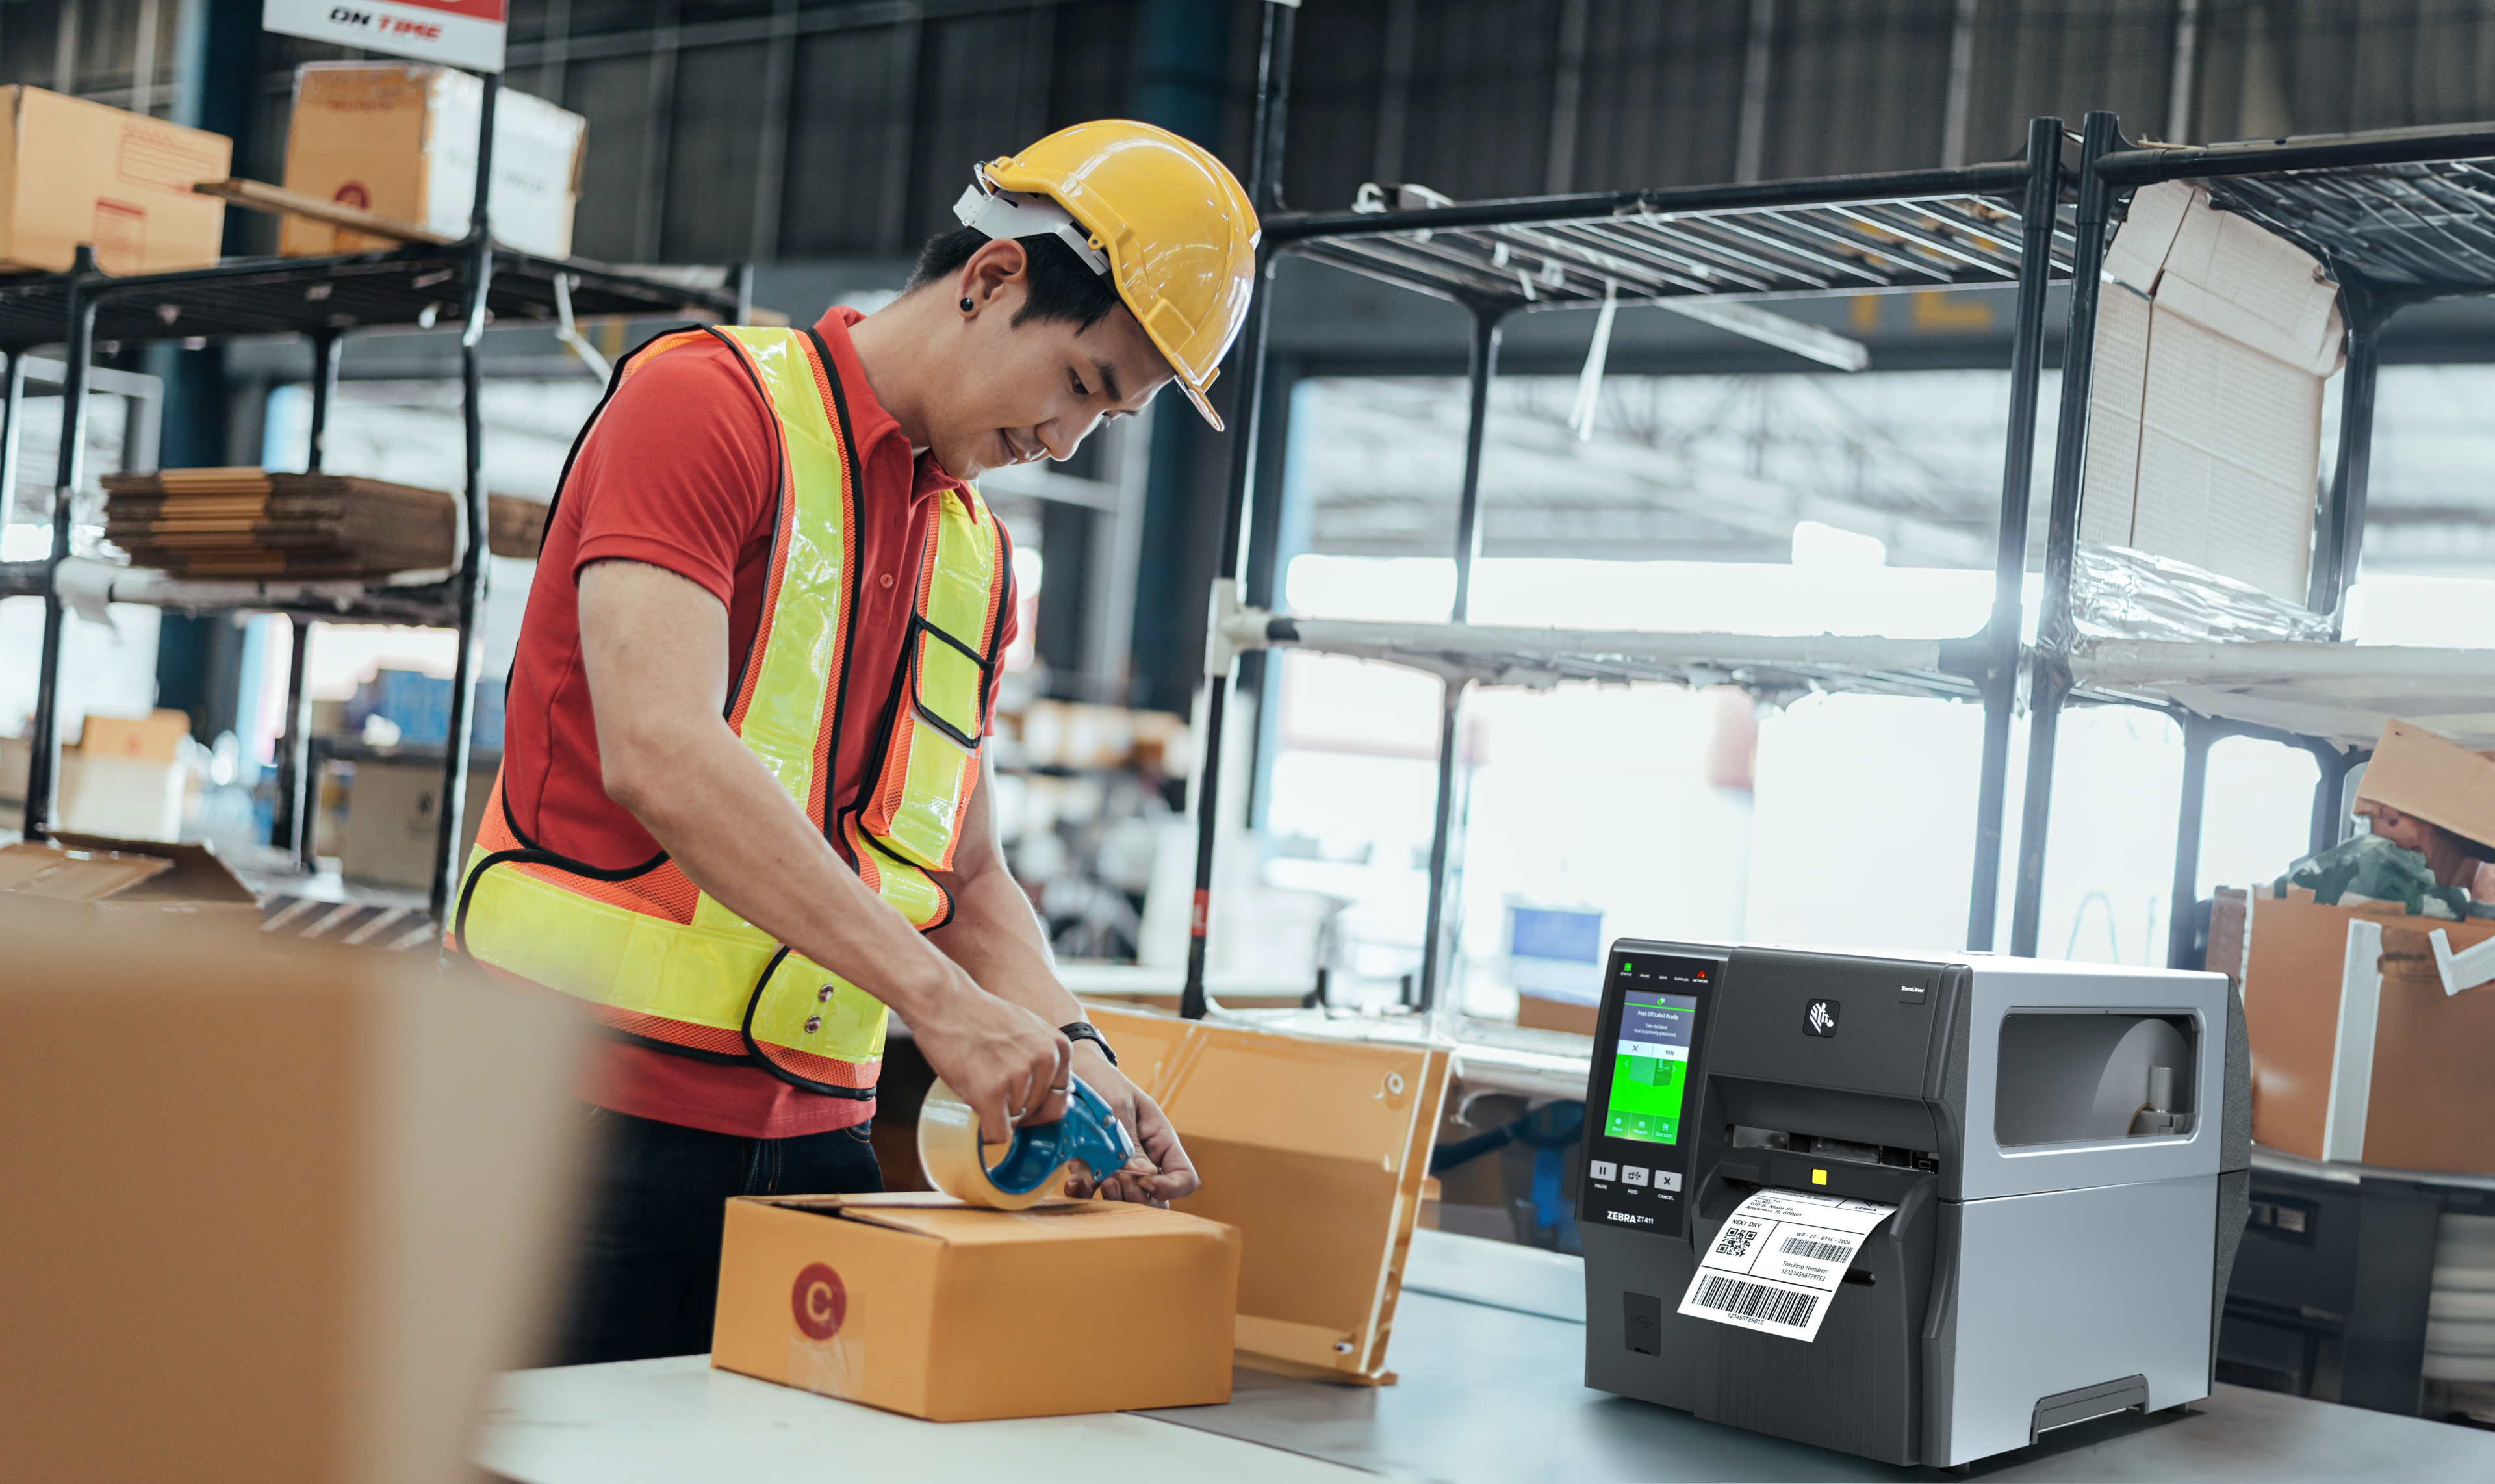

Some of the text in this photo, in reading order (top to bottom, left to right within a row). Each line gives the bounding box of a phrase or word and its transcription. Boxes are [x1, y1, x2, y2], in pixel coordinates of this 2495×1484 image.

[329, 6, 370, 25] ON
[379, 16, 442, 40] TIME
[1607, 1210, 1654, 1224] ZEBRA ZT411
[1783, 1260, 1828, 1274] Tracking Number:
[806, 1280, 832, 1322] C
[1727, 1312, 1765, 1325] 123456789012
